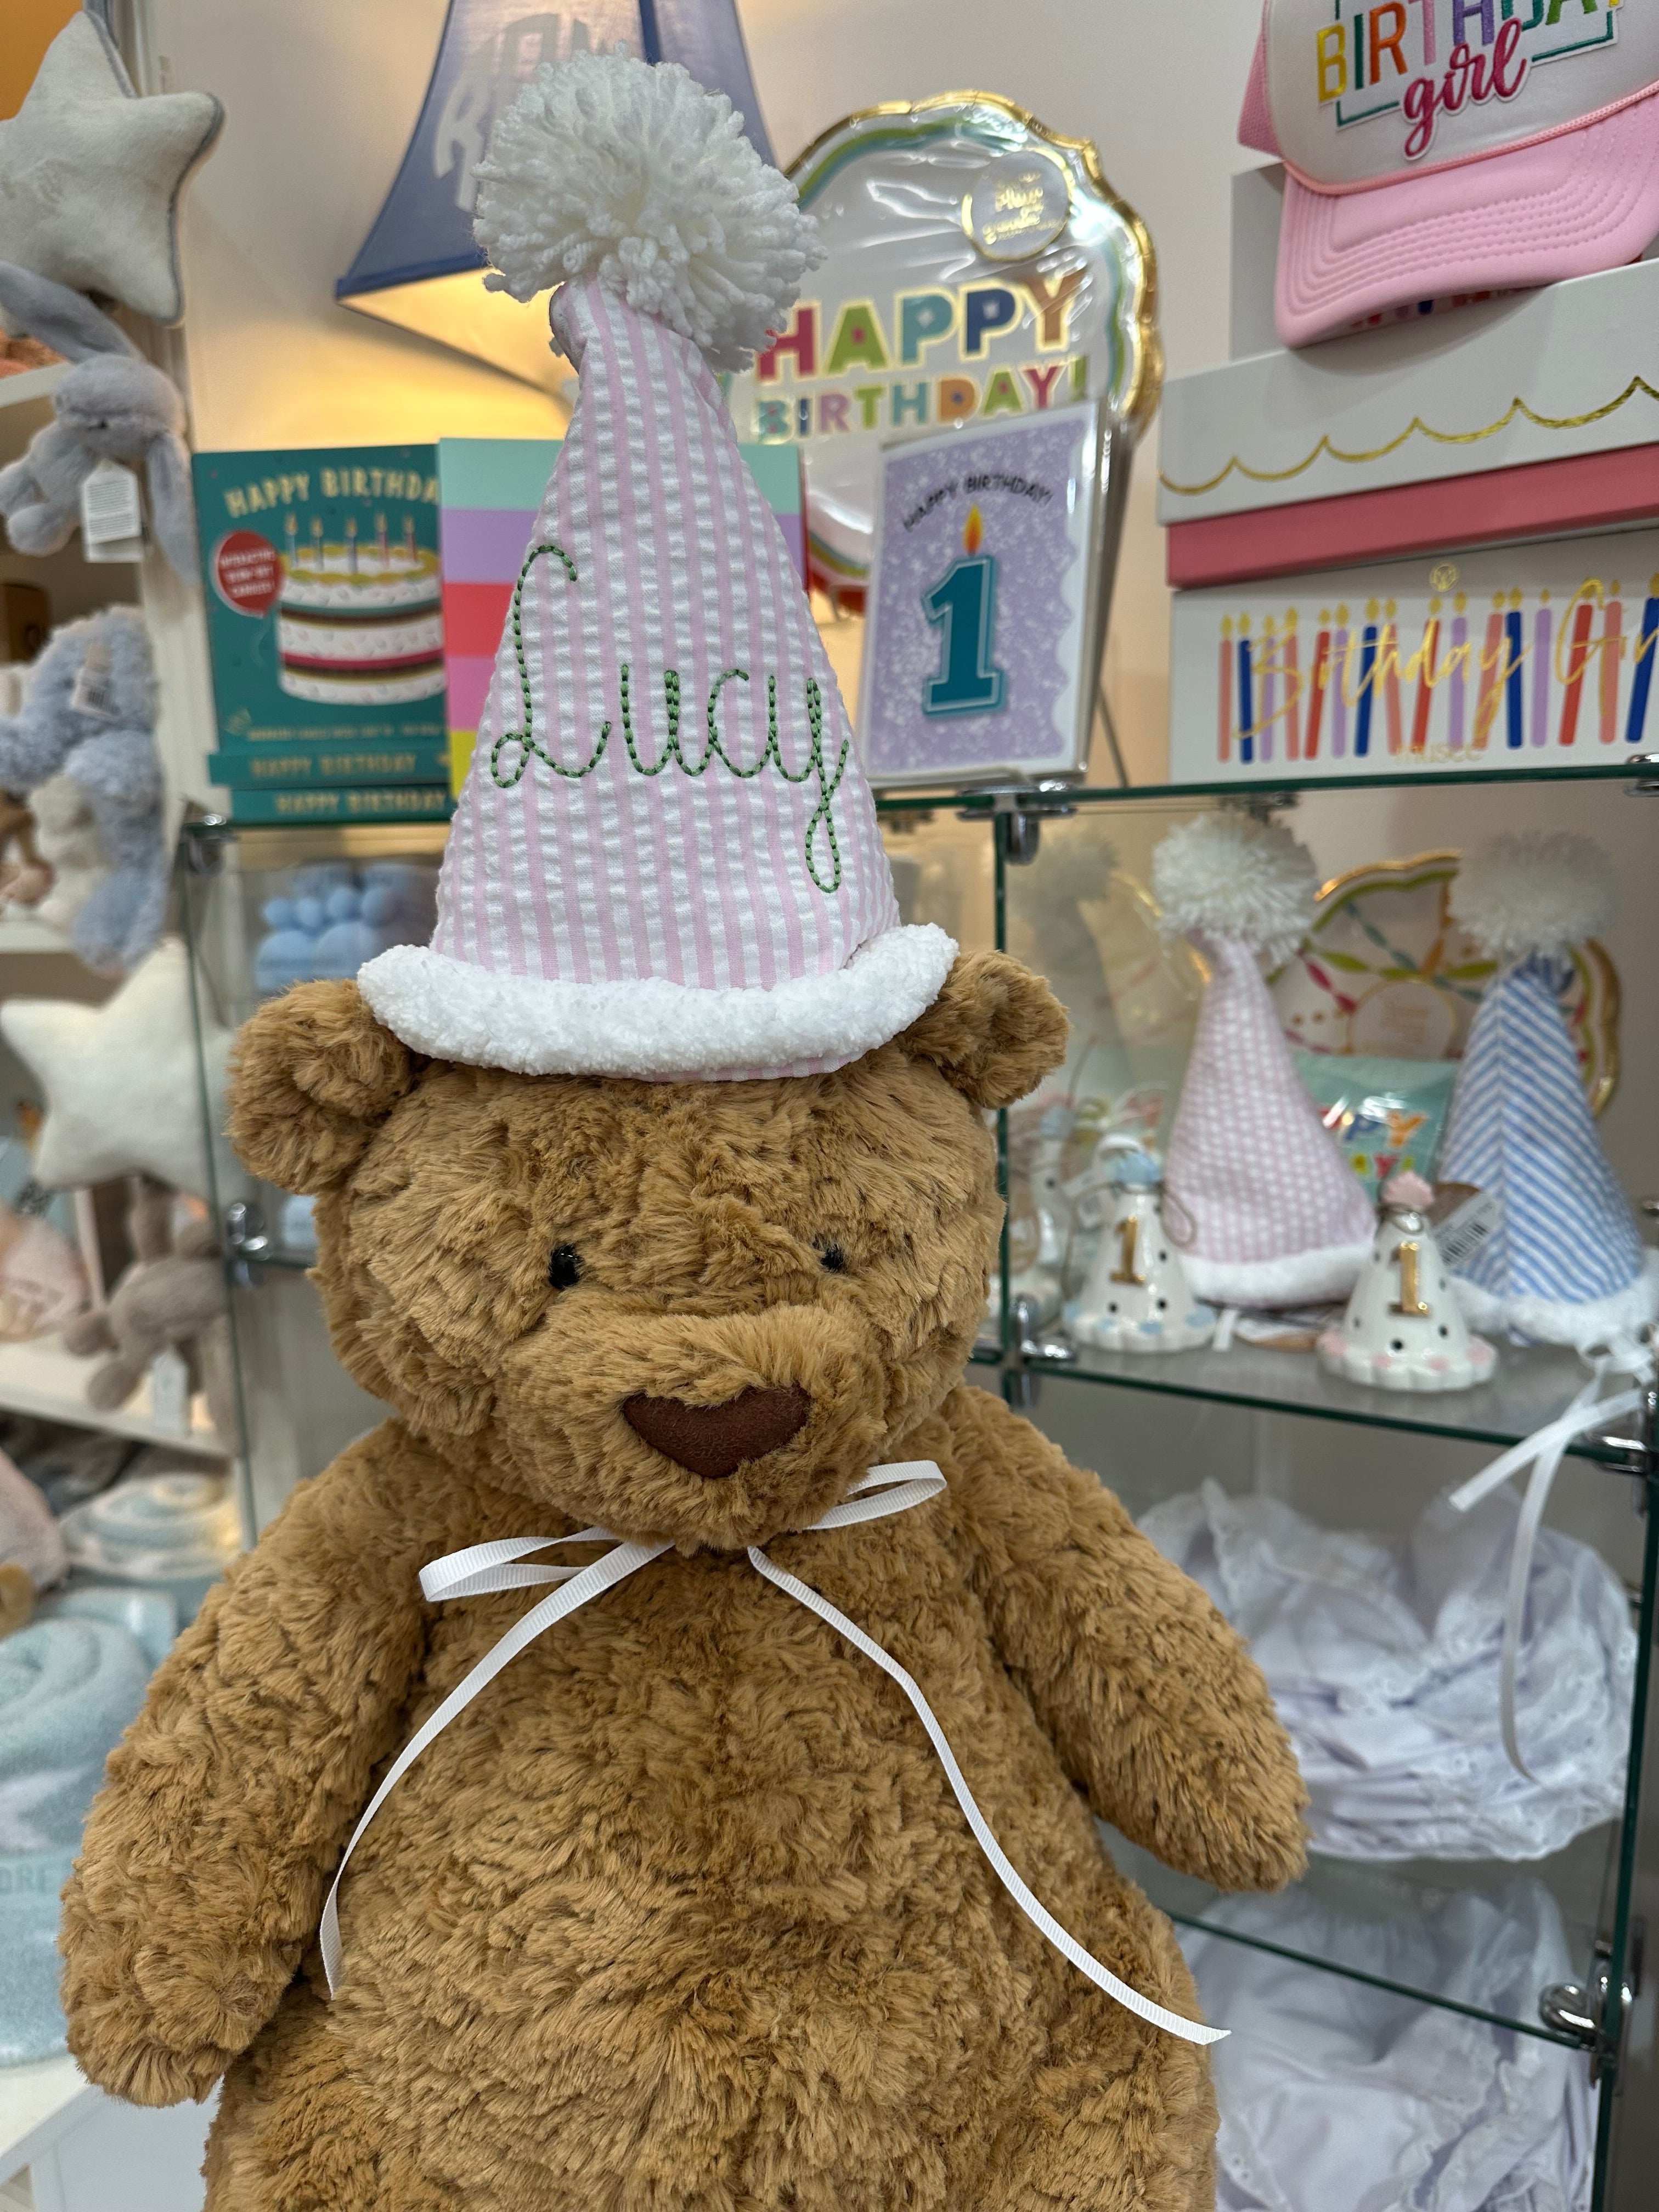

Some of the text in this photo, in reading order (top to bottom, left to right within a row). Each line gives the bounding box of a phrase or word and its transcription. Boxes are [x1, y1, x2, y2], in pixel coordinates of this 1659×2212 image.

[1318, 0, 1620, 103] BIRTH
[1403, 18, 1528, 159] girl
[755, 268, 1090, 384] HAPPY
[754, 353, 1091, 444] BIRTHDAY!
[224, 466, 439, 518] HAPPY BIRTHDA
[902, 478, 959, 533] HAPPY
[920, 554, 1009, 720] 1
[1232, 577, 1659, 742] Birthday Gir
[490, 544, 849, 894] Lucy
[1108, 1214, 1147, 1286] 1
[1386, 1240, 1433, 1317] 1
